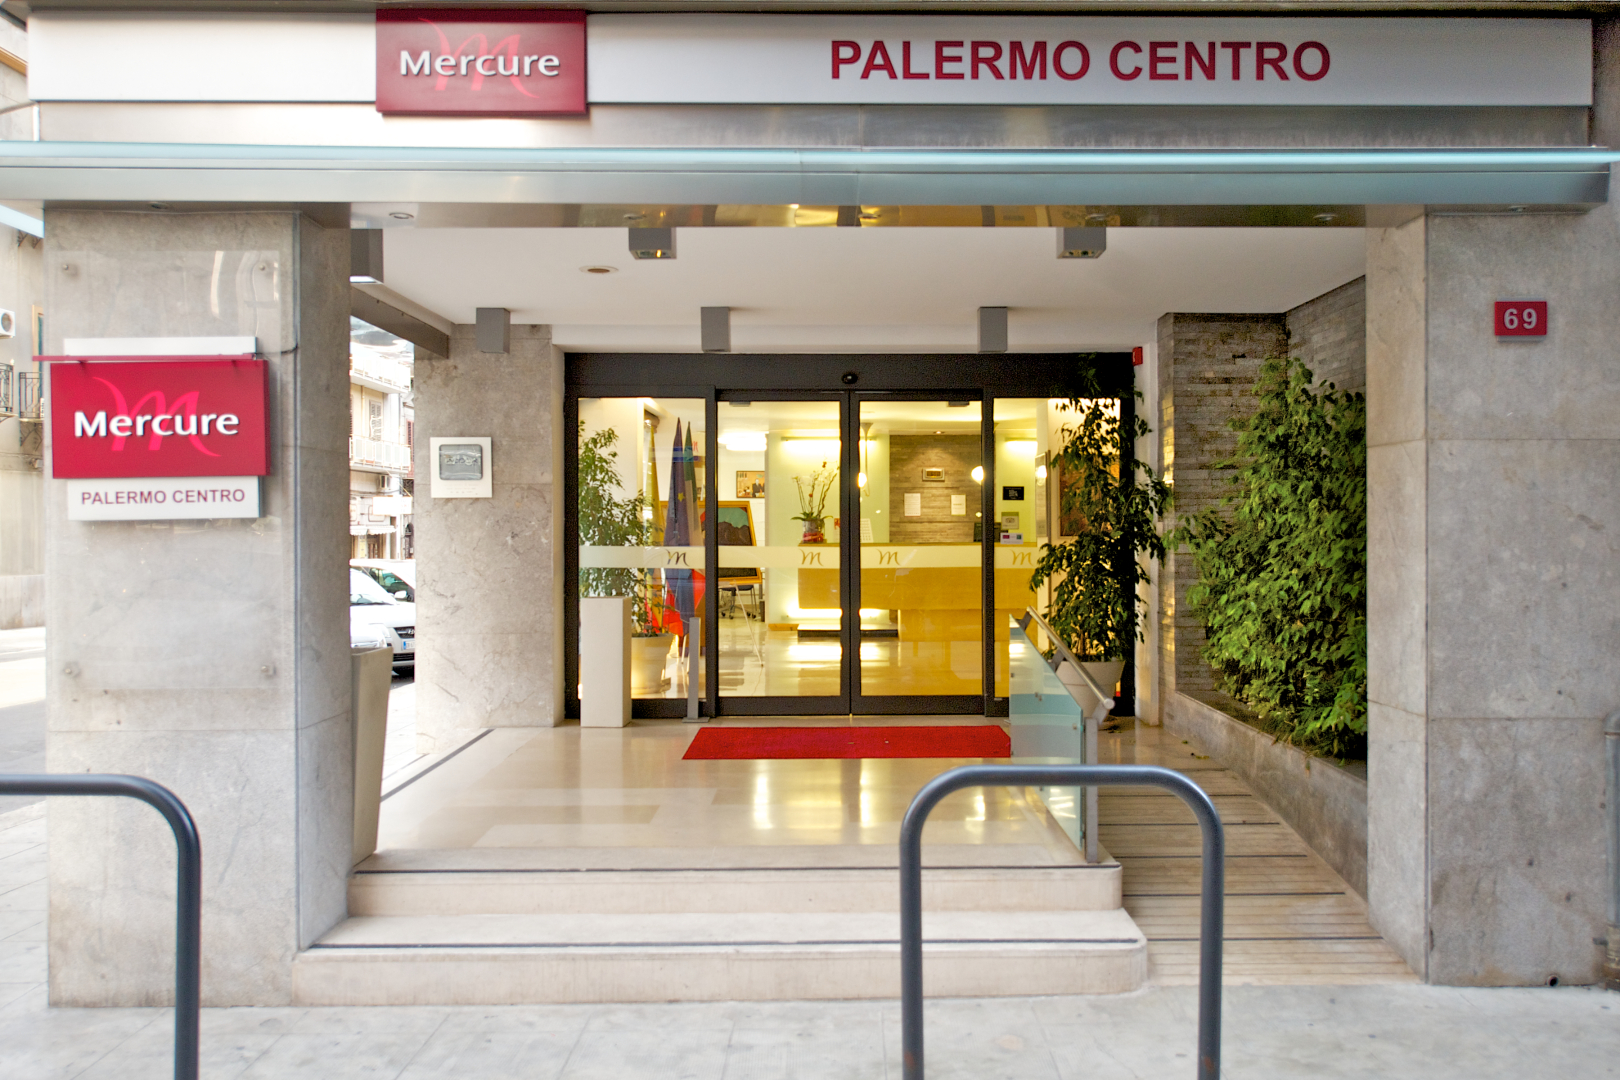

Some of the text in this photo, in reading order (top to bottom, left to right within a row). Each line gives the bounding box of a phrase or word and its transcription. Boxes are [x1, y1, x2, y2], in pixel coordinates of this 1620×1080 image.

[400, 50, 560, 77] Mercure
[831, 40, 1331, 81] PALERMO CENTRO
[1504, 308, 1536, 330] 69
[74, 410, 239, 438] Mercure
[81, 489, 246, 505] PALERMO CENTRO
